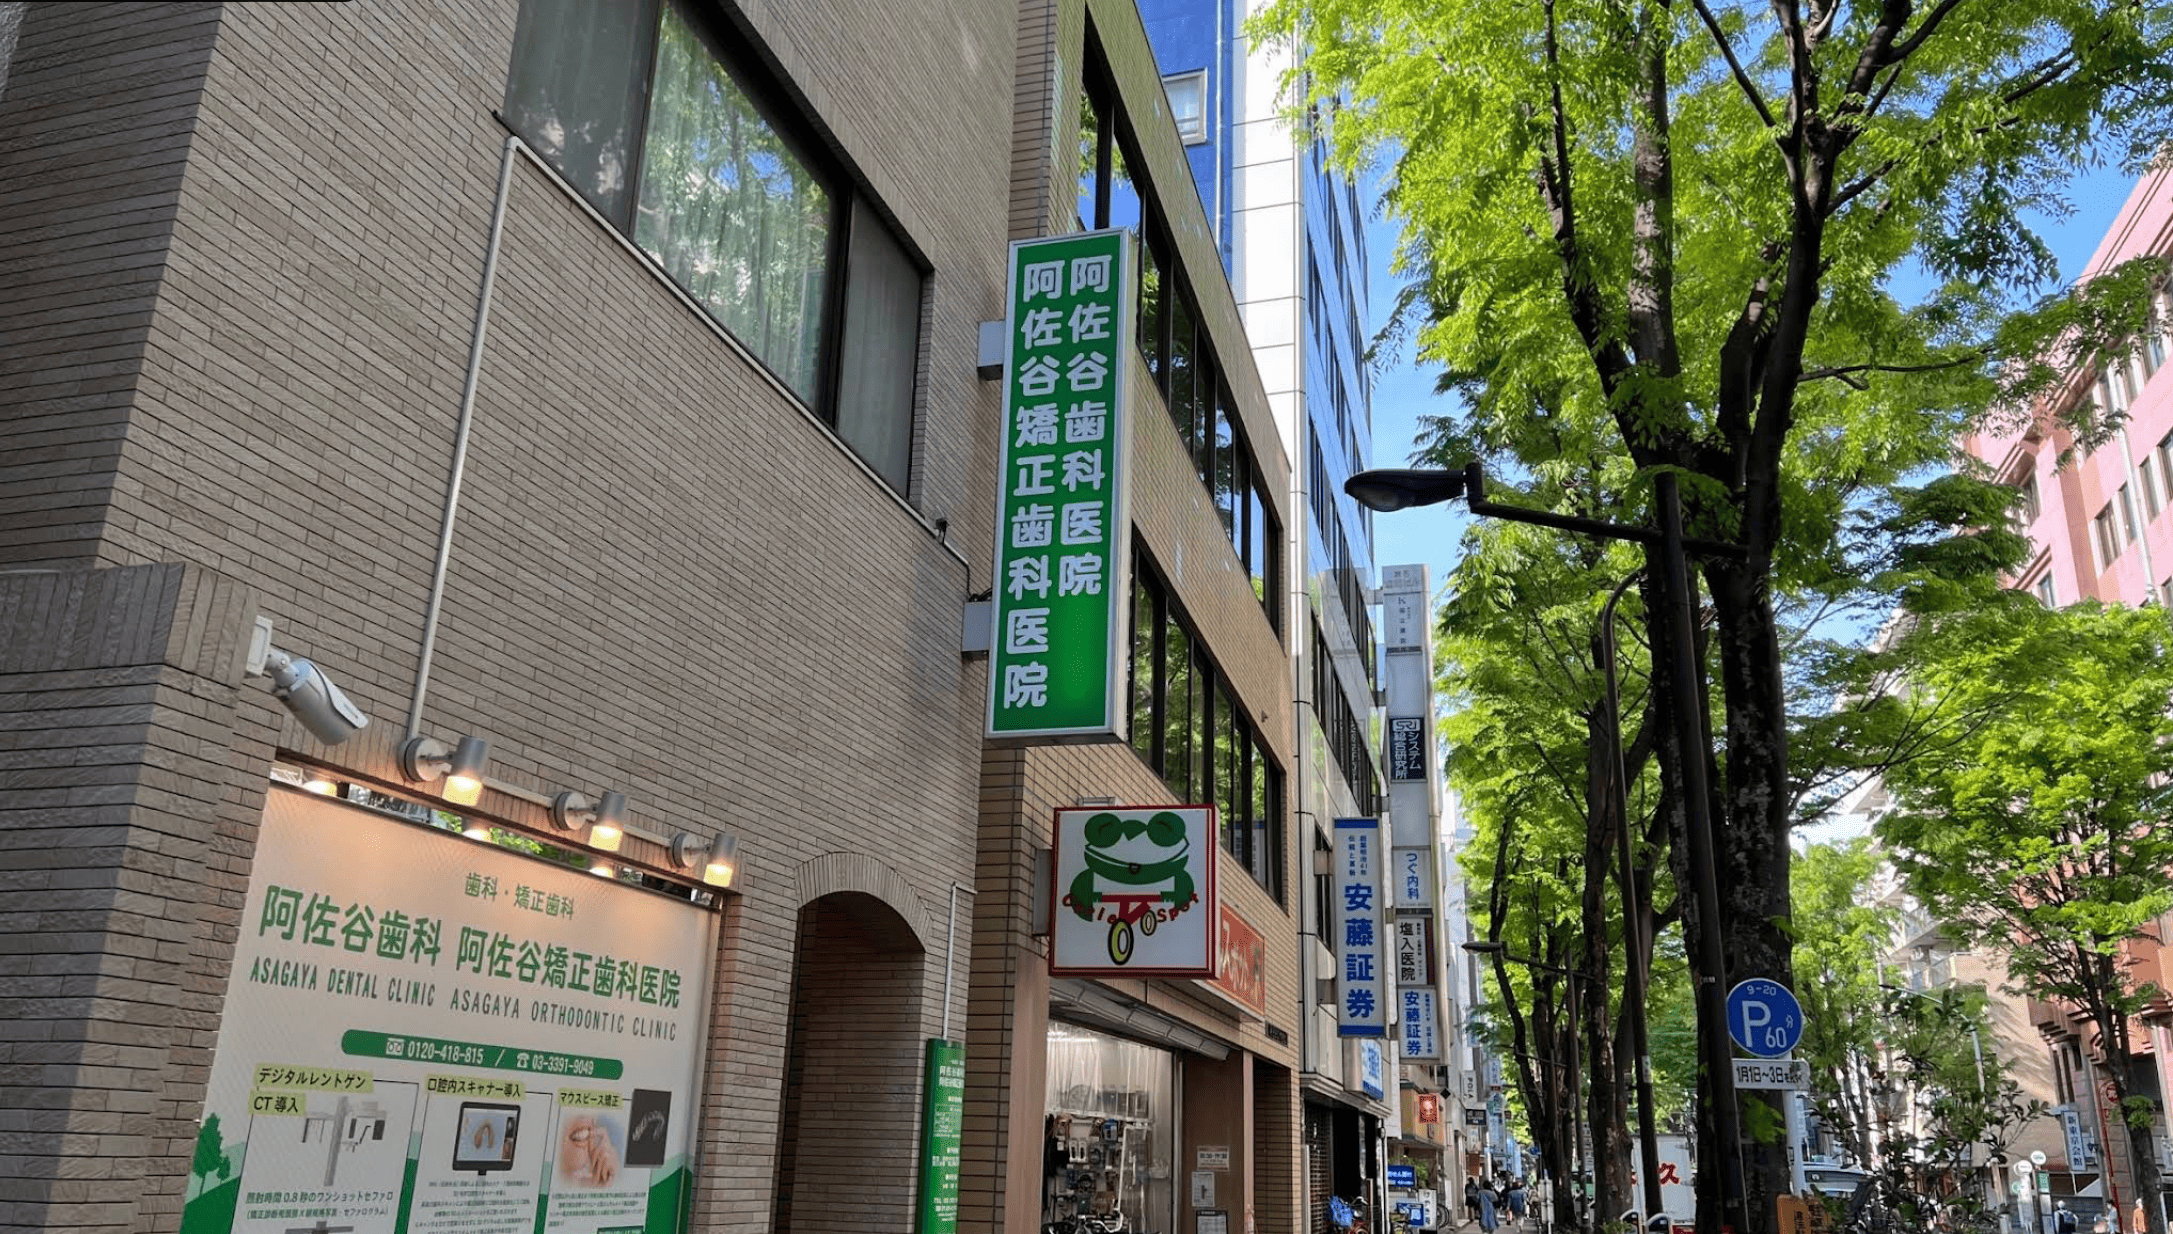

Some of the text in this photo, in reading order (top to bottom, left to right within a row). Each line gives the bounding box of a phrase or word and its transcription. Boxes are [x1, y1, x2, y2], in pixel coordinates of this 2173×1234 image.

[1058, 254, 1112, 597] 阿佐谷歯科医院
[1003, 259, 1065, 709] 阿佐谷矯正歯科医院
[1407, 732, 1422, 770] システム
[464, 872, 575, 920] 歯科・矯正歯科
[1405, 853, 1420, 900] つぐ内科
[258, 885, 682, 1009] 阿佐谷歯科 阿佐谷矯正歯科医院
[1344, 883, 1375, 1018] 安藤証券
[1399, 921, 1416, 981] 塩入医院
[250, 956, 676, 1041] ASAGAYA DENTAL CLINIC ASAGAYA ORTHODONTIC CLINIC
[1746, 984, 1777, 996] 9-20
[1404, 990, 1422, 1056] 安藤証券
[1742, 1000, 1771, 1048] P
[258, 1067, 366, 1089] デジタルレントゲン
[407, 1041, 483, 1066] 0120-418-815
[532, 1054, 594, 1075] 03-3391-9049
[427, 1078, 521, 1097] 口腔内スキャナー導入
[560, 1092, 620, 1108] マウスピース矯正
